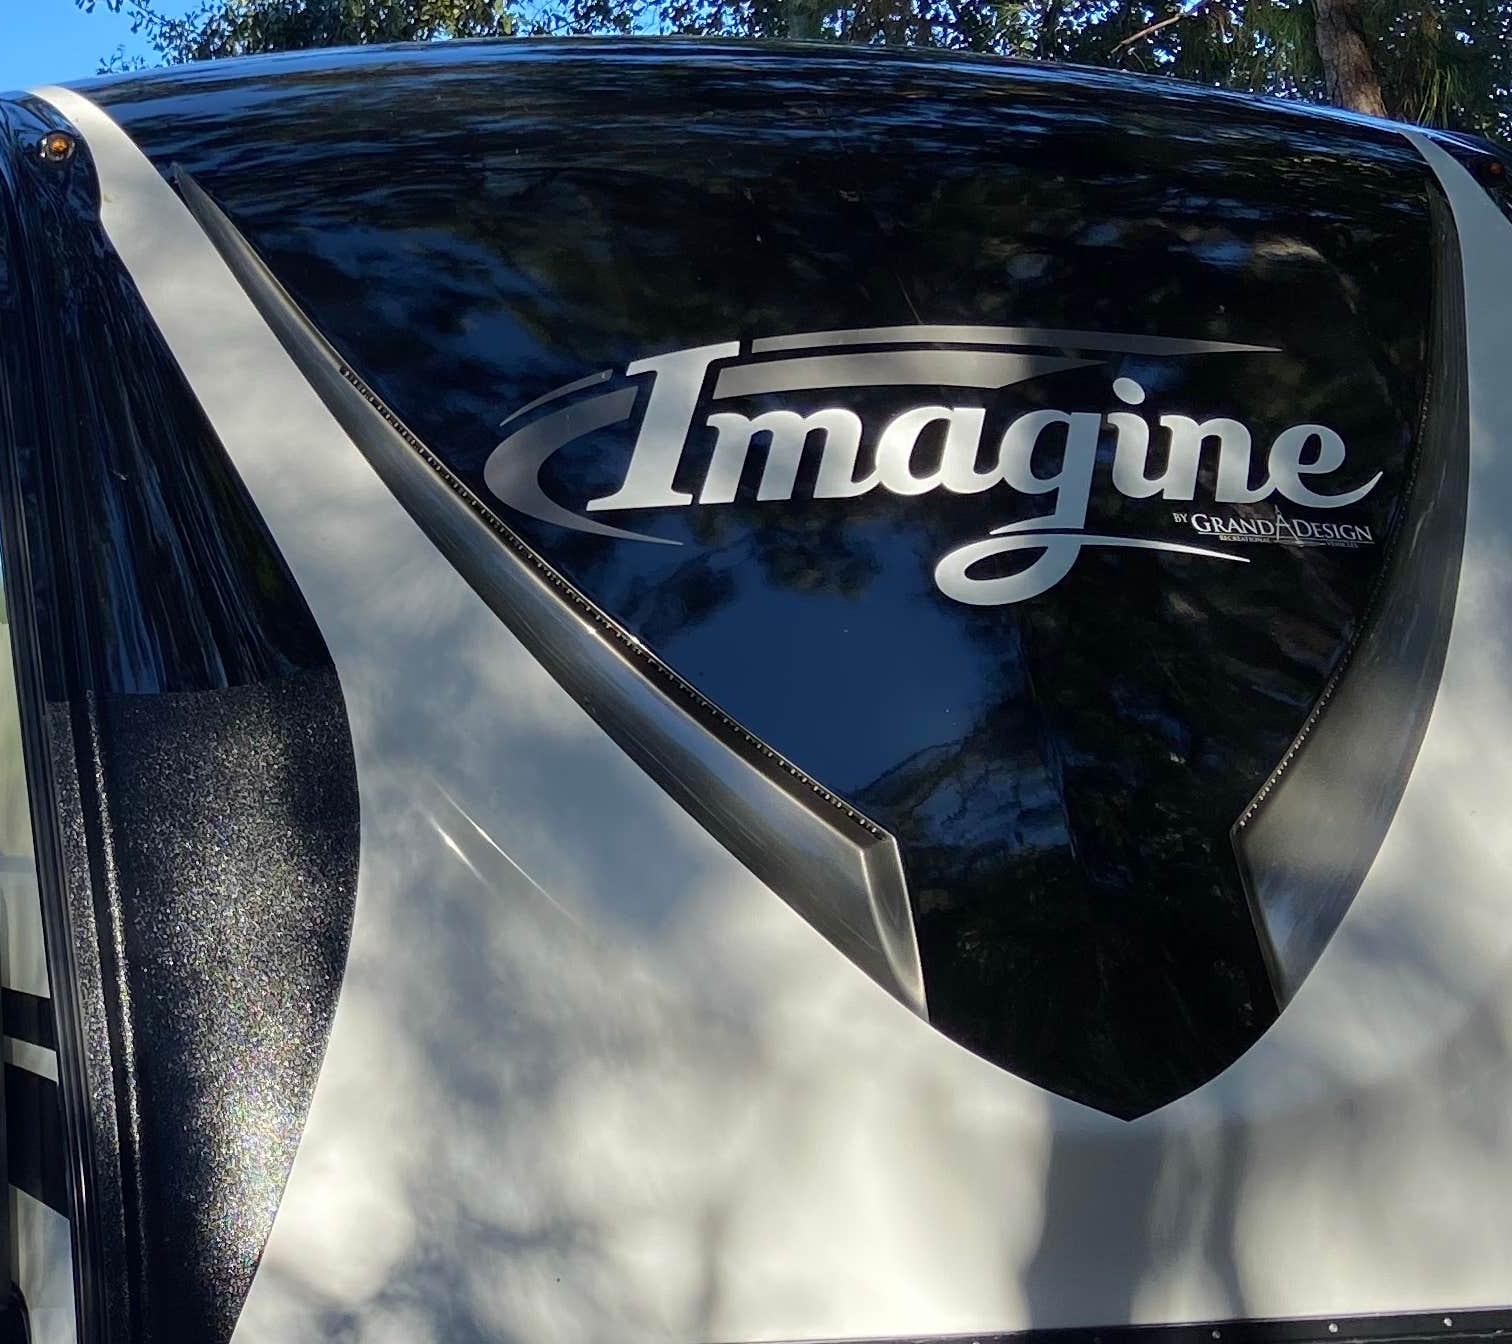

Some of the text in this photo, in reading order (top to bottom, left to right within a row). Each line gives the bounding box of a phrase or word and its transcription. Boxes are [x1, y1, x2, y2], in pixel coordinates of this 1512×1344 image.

[586, 340, 1384, 605] Imagine
[1172, 512, 1373, 542] BY GRAND DESIGN
